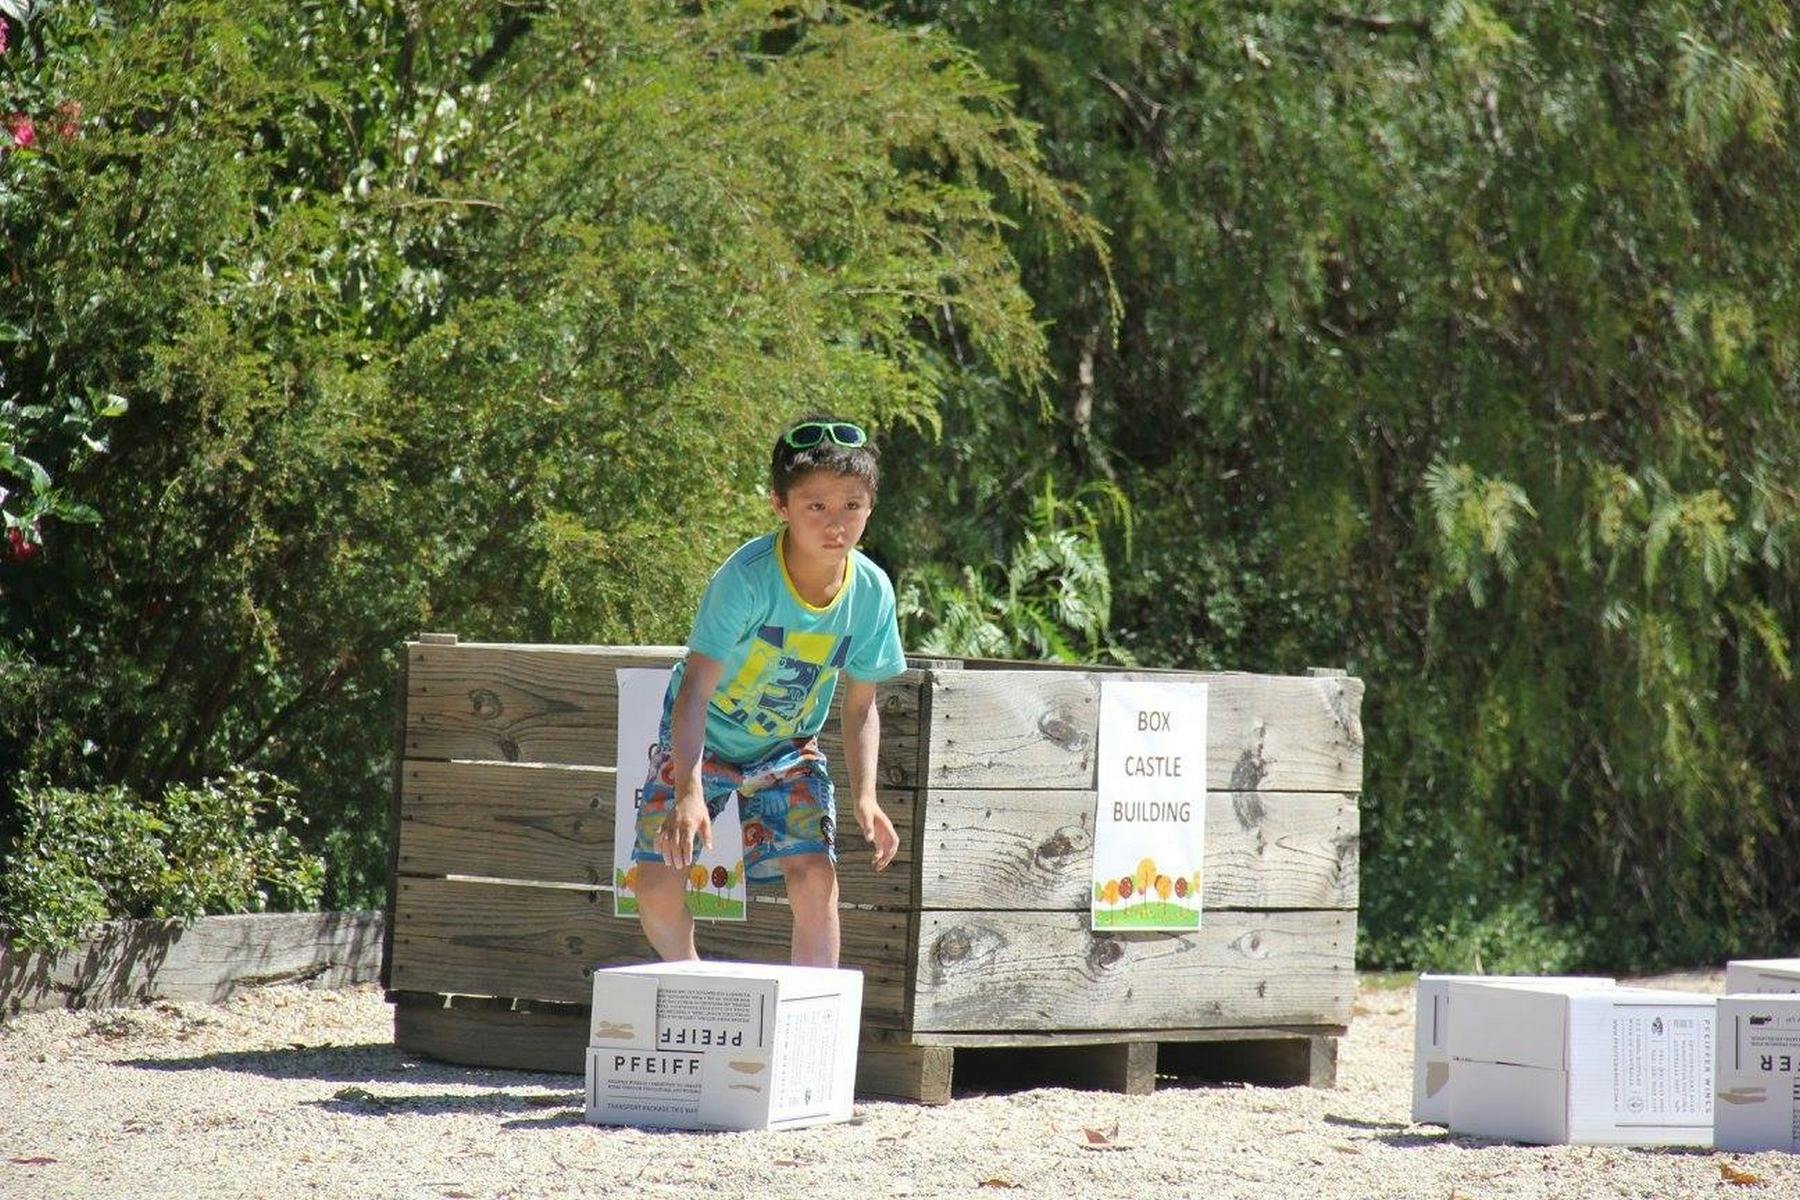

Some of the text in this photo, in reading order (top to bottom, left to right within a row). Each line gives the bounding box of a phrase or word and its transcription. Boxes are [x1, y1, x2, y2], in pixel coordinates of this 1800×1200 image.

[1137, 710, 1171, 732] BOX
[1125, 756, 1182, 777] CASTLE
[1113, 801, 1191, 823] BUILDING
[661, 1028, 742, 1047] PFEIFF
[614, 1055, 700, 1075] PFEIFF
[1760, 1055, 1800, 1071] ER
